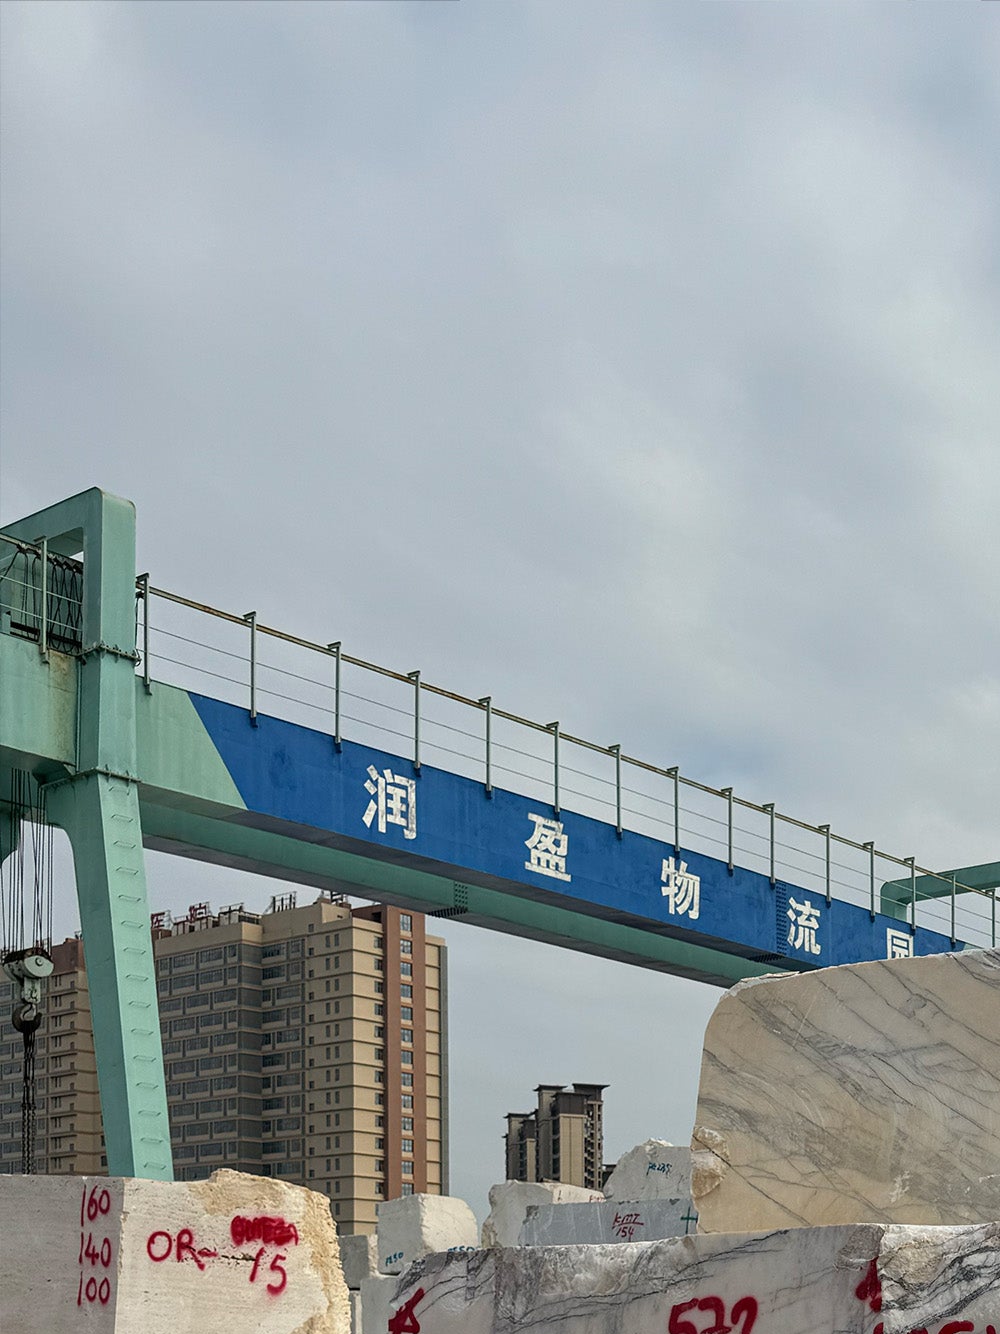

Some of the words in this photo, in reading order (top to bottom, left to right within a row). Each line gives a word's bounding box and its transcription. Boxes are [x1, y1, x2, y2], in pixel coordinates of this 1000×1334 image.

[80, 1184, 111, 1227] 160
[78, 1232, 112, 1268] 140
[76, 1270, 111, 1307] 100
